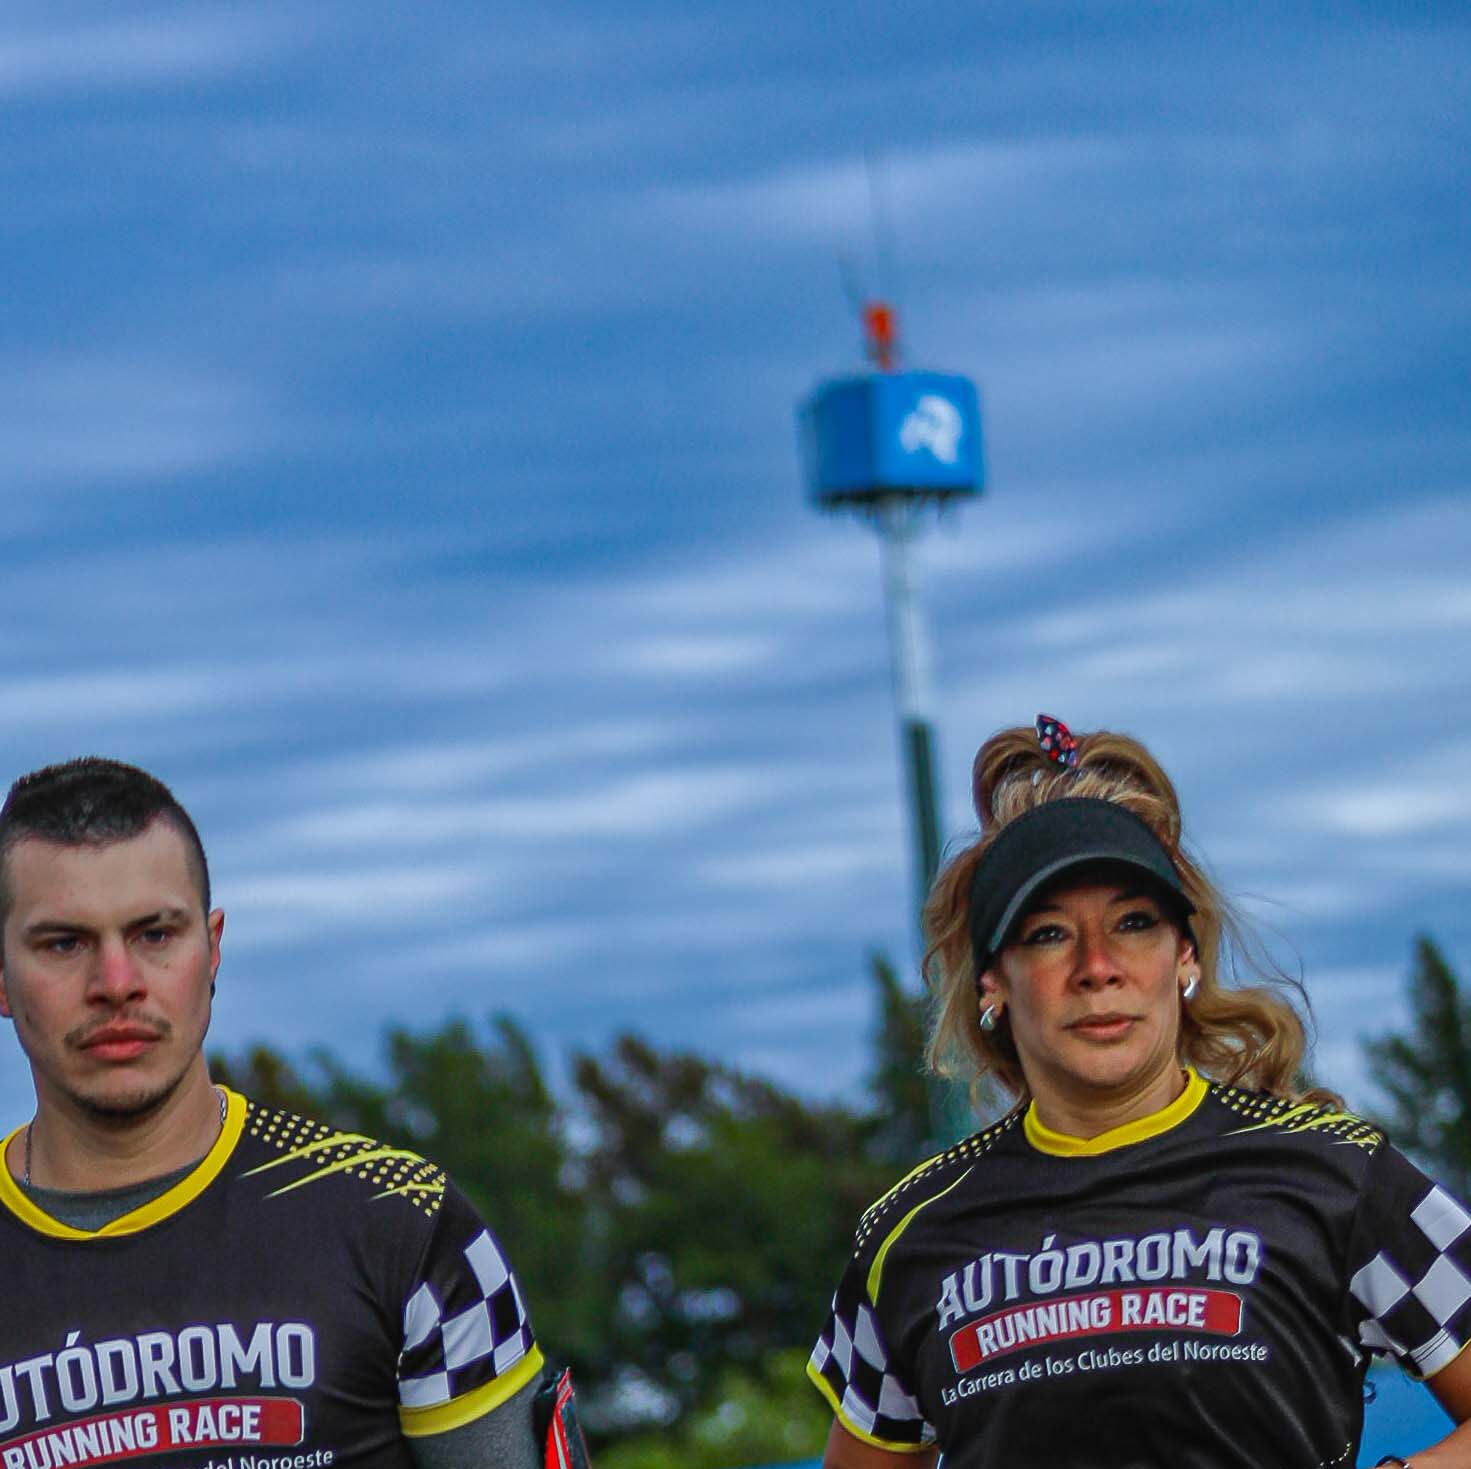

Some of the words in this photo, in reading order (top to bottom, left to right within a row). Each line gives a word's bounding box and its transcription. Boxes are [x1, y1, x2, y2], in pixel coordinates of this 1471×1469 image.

[935, 1228, 1261, 1331] AUTÓDROMO
[976, 1296, 1111, 1357] RUNNING
[1121, 1292, 1207, 1328] RACE
[941, 1388, 957, 1406] La
[957, 1370, 1014, 1398] Carrera
[1019, 1362, 1042, 1382] de
[1046, 1356, 1075, 1376] los
[1078, 1345, 1143, 1370] Clubes
[1148, 1340, 1178, 1362] del
[1184, 1340, 1268, 1361] Noroeste
[169, 1404, 262, 1444] RACE
